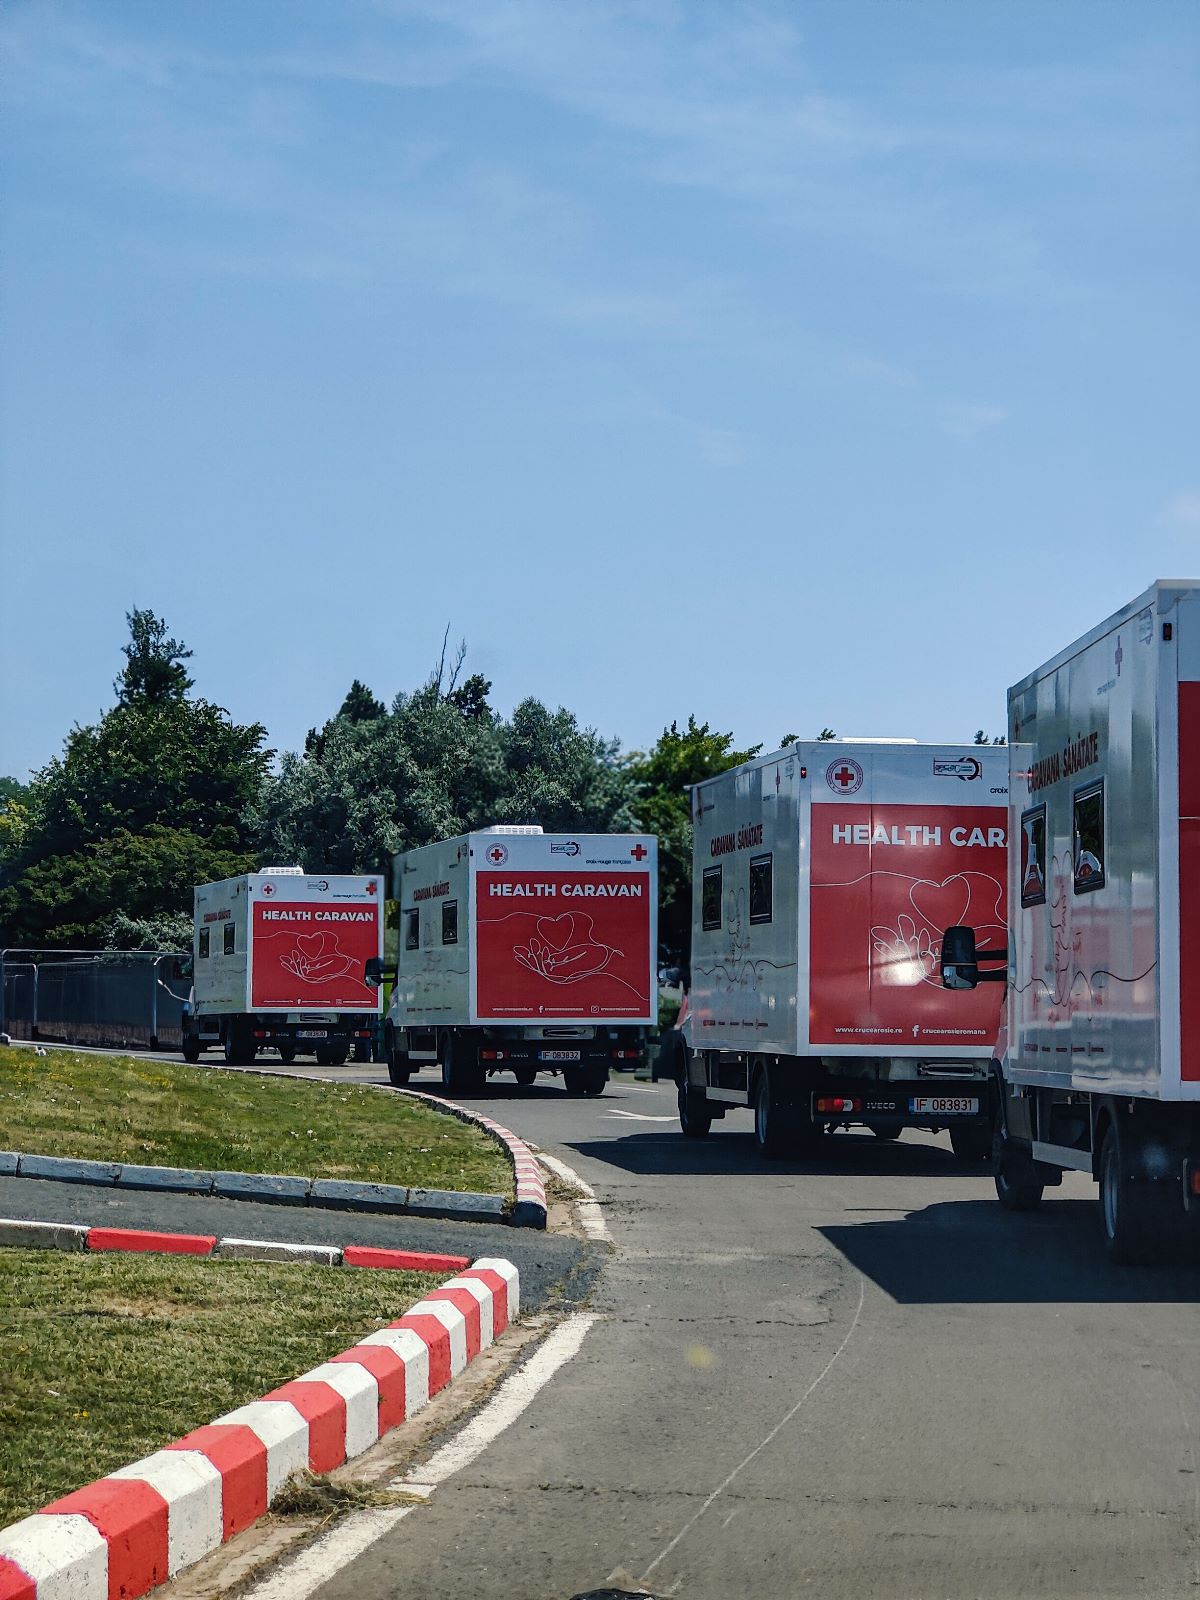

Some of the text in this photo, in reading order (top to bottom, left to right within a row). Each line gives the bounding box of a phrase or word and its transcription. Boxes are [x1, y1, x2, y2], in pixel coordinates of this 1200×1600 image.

[832, 824, 1009, 848] HEALTH CAR
[489, 884, 642, 897] HEALTH CARAVAN
[262, 911, 374, 922] HEALTH CARAVAN
[866, 1102, 896, 1110] IVECO
[916, 1099, 972, 1111] IF 083831
